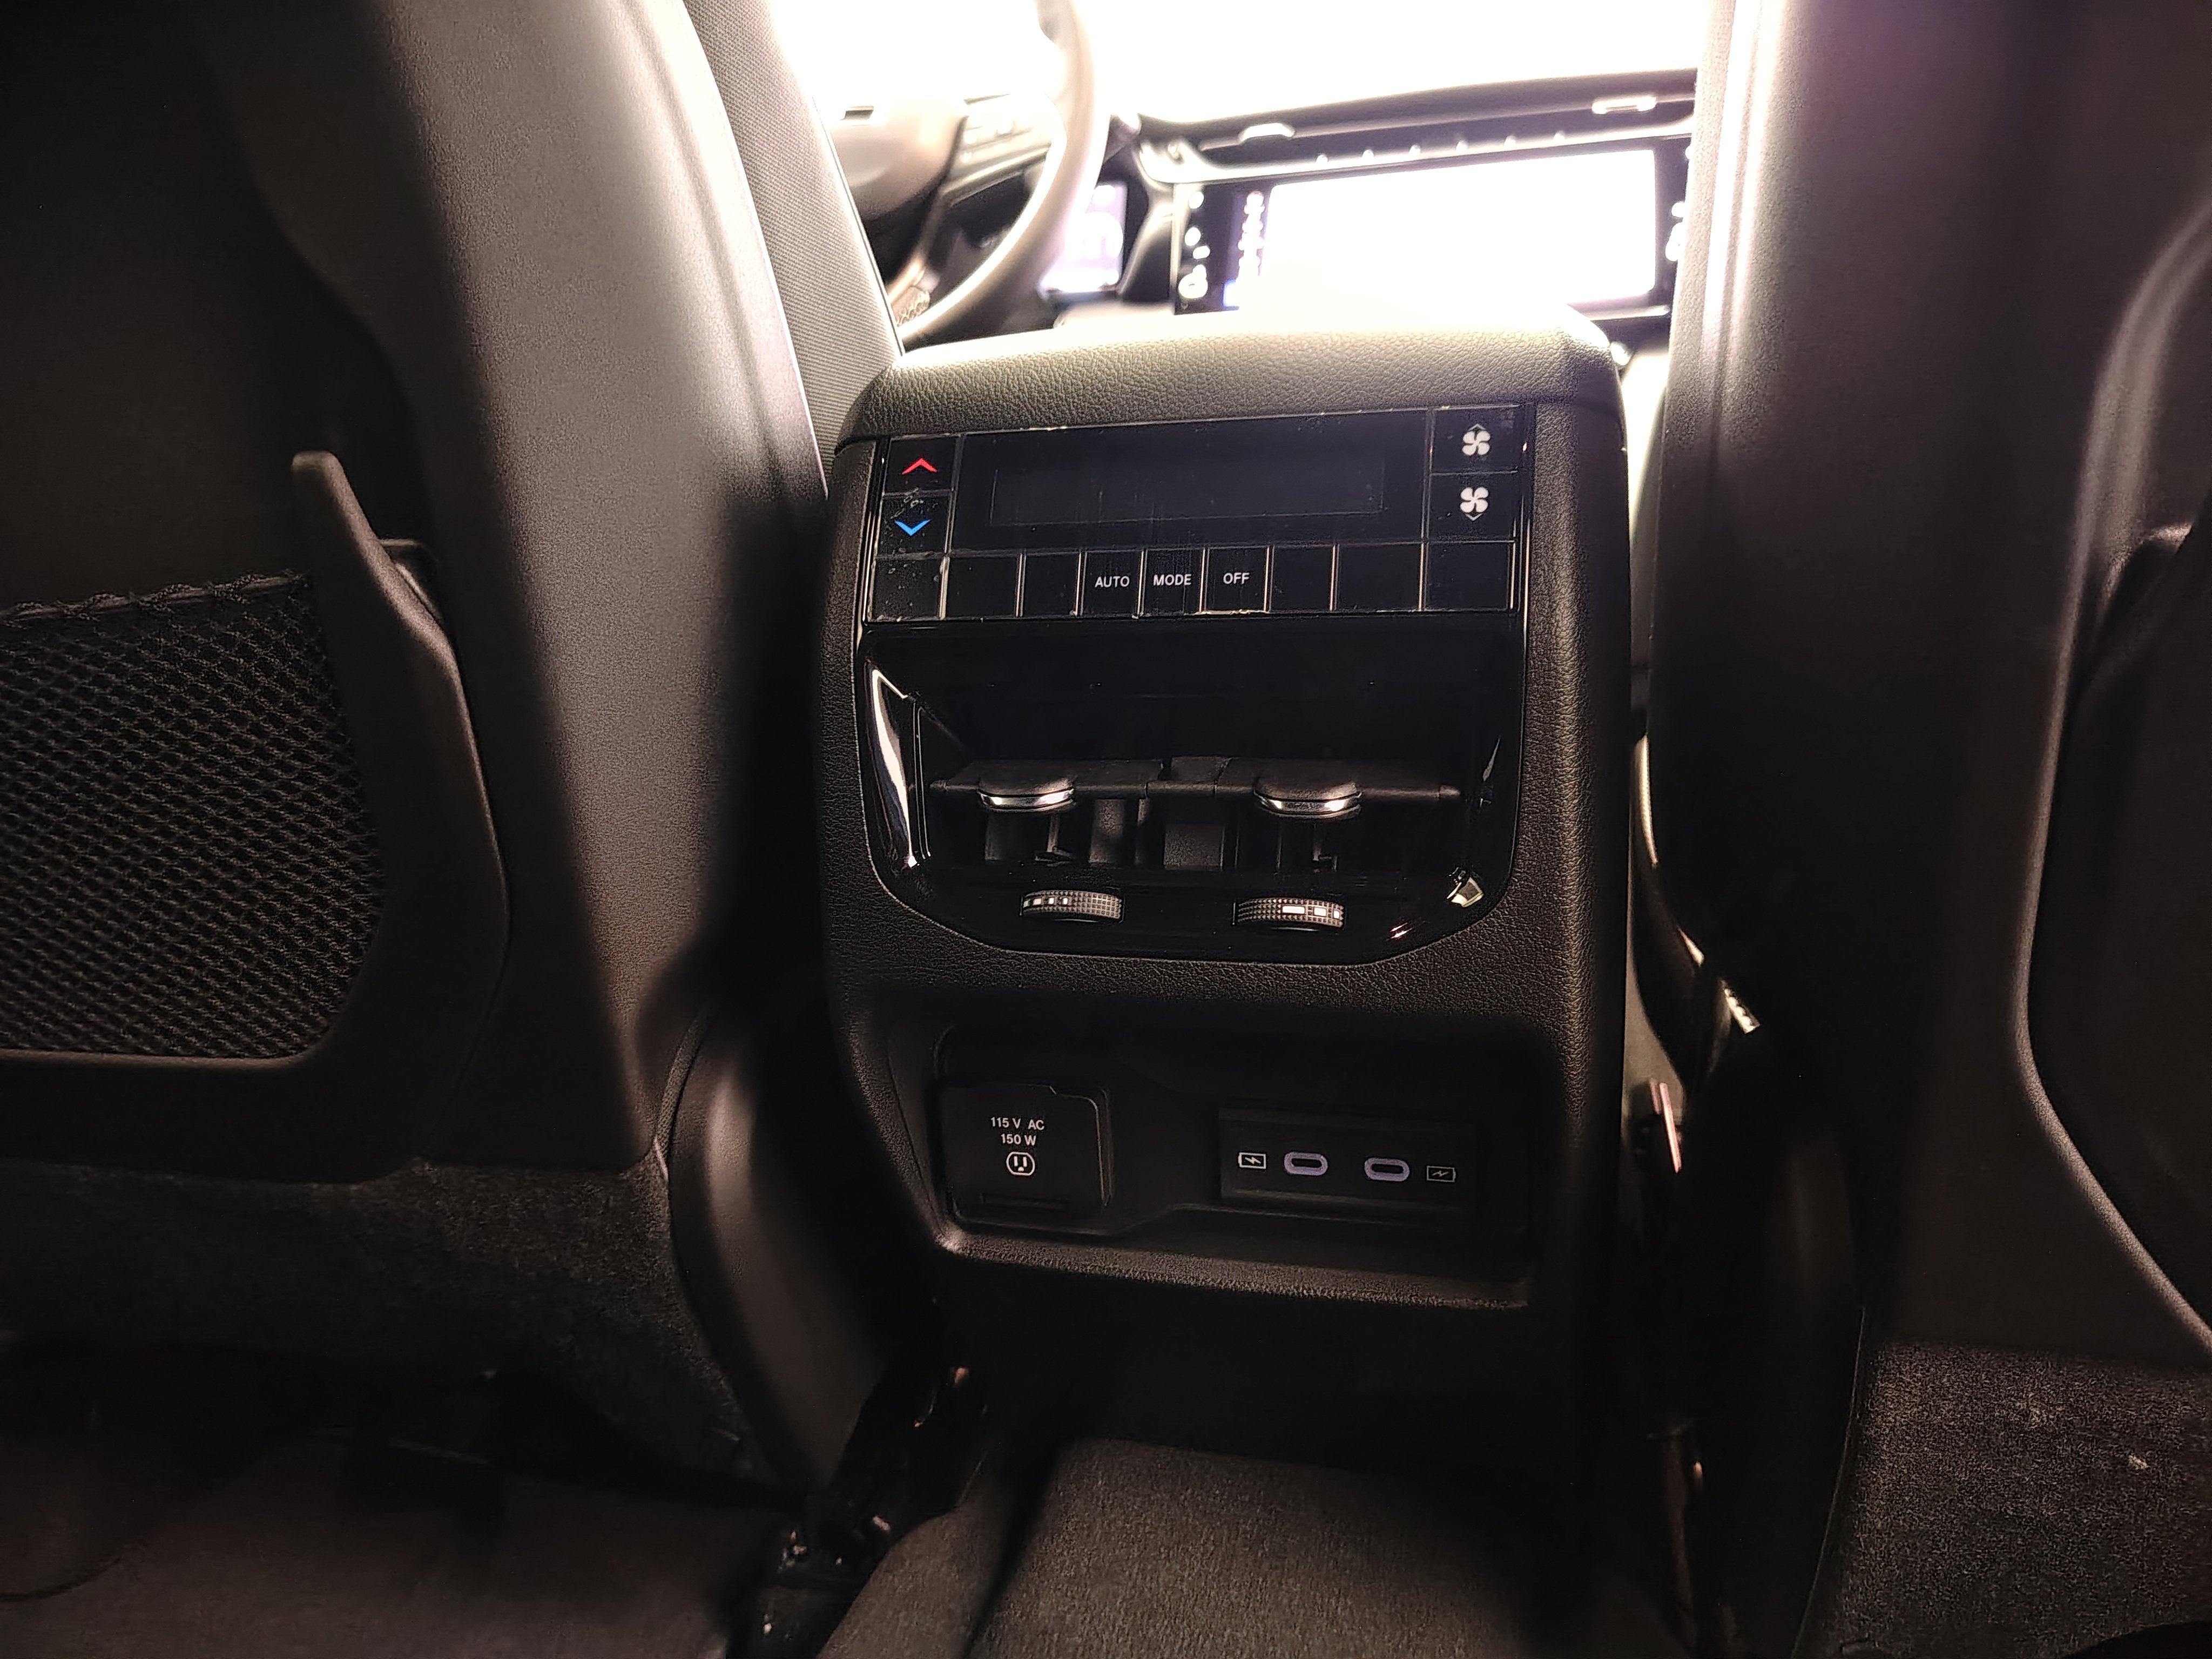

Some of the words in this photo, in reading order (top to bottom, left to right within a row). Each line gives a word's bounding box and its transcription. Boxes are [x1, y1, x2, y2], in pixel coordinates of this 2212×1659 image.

[1094, 576, 1130, 588] AUTO
[1153, 574, 1192, 586] MODE
[1223, 572, 1250, 585] OFF
[1028, 1119, 1045, 1131] AC
